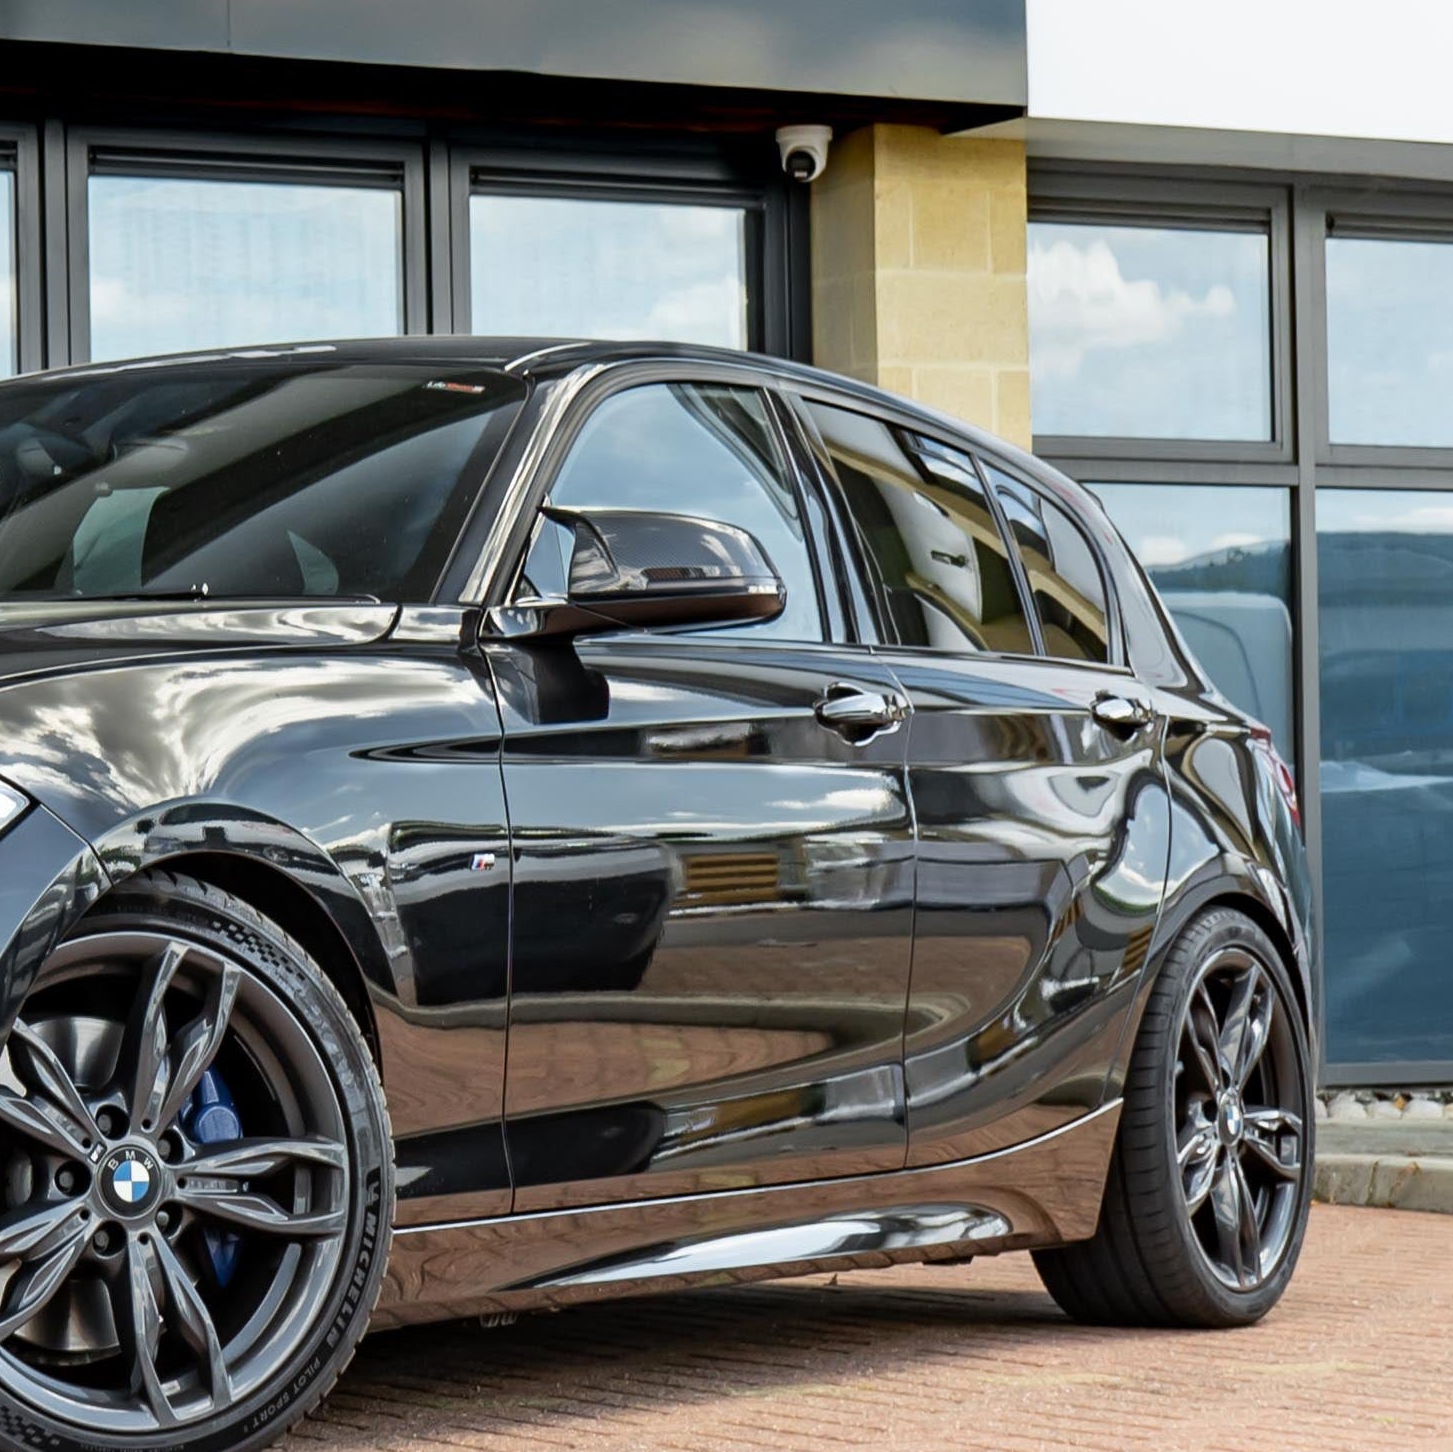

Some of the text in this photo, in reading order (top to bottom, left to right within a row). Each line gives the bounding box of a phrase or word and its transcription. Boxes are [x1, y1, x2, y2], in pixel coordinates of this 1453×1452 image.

[108, 1150, 154, 1171] BMW
[252, 1211, 377, 1428] MICHELIN PILOT SPORT
